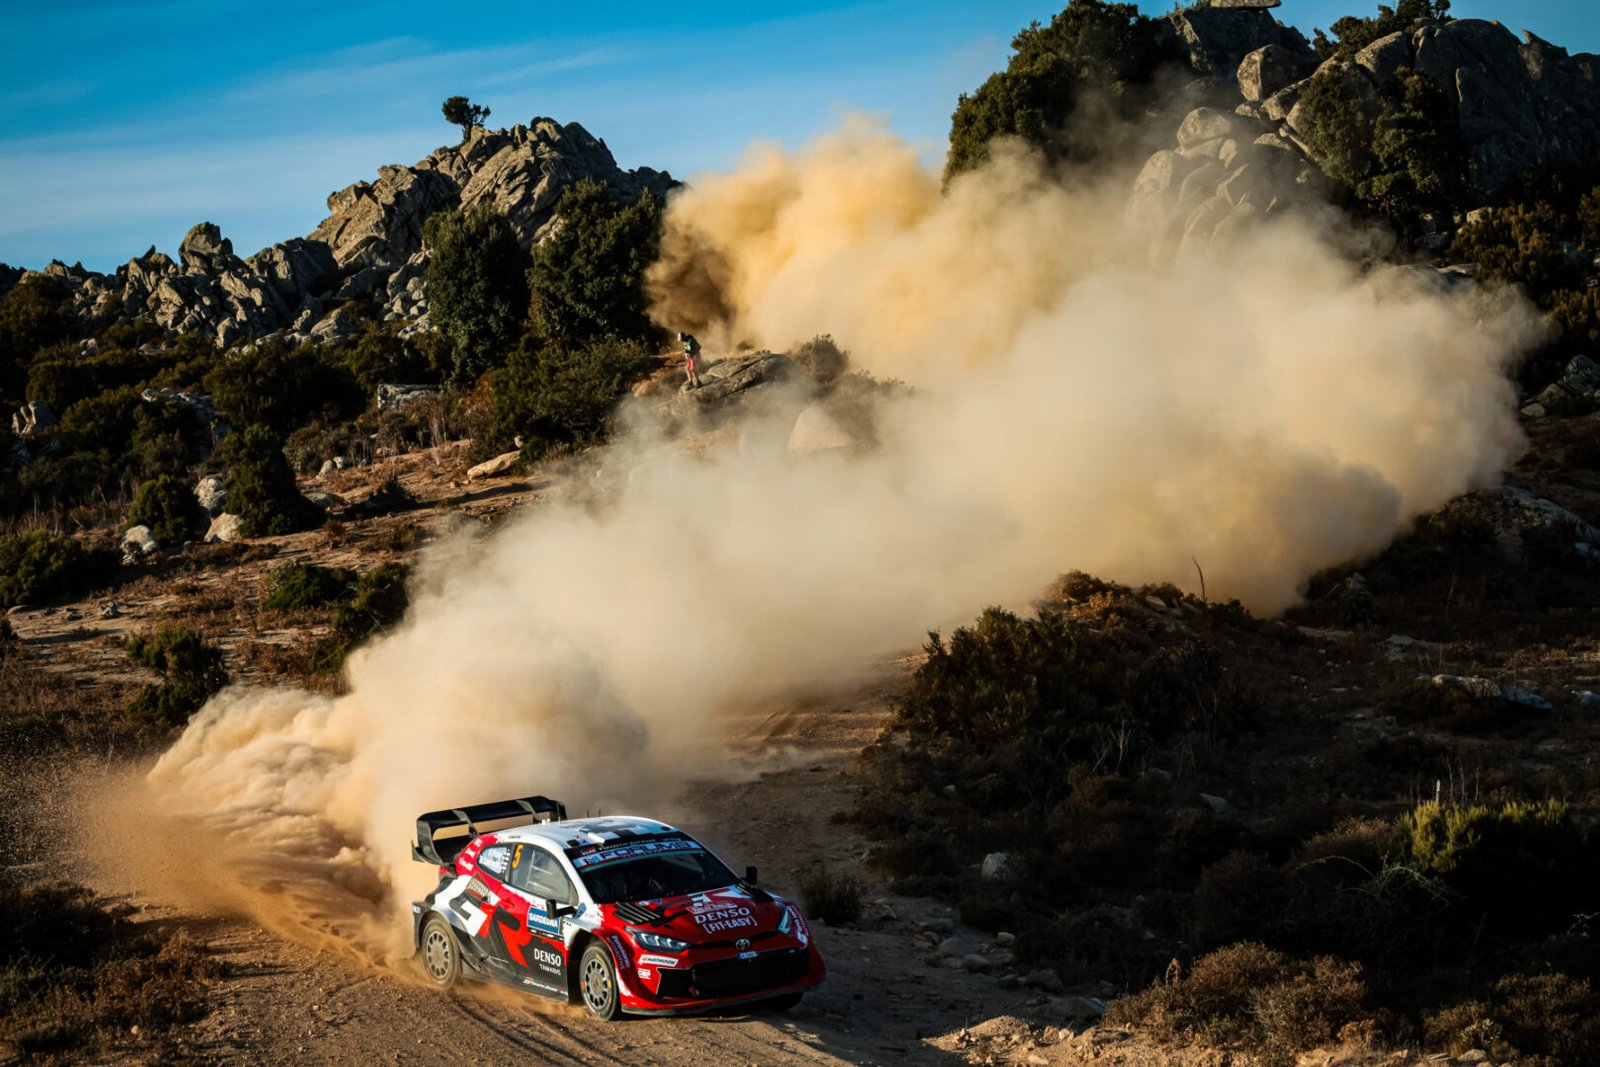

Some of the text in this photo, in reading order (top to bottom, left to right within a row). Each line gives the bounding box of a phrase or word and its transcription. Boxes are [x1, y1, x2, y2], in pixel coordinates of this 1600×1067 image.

[512, 845, 524, 869] 5
[694, 907, 751, 924] DENSO
[534, 948, 562, 967] DENSO
